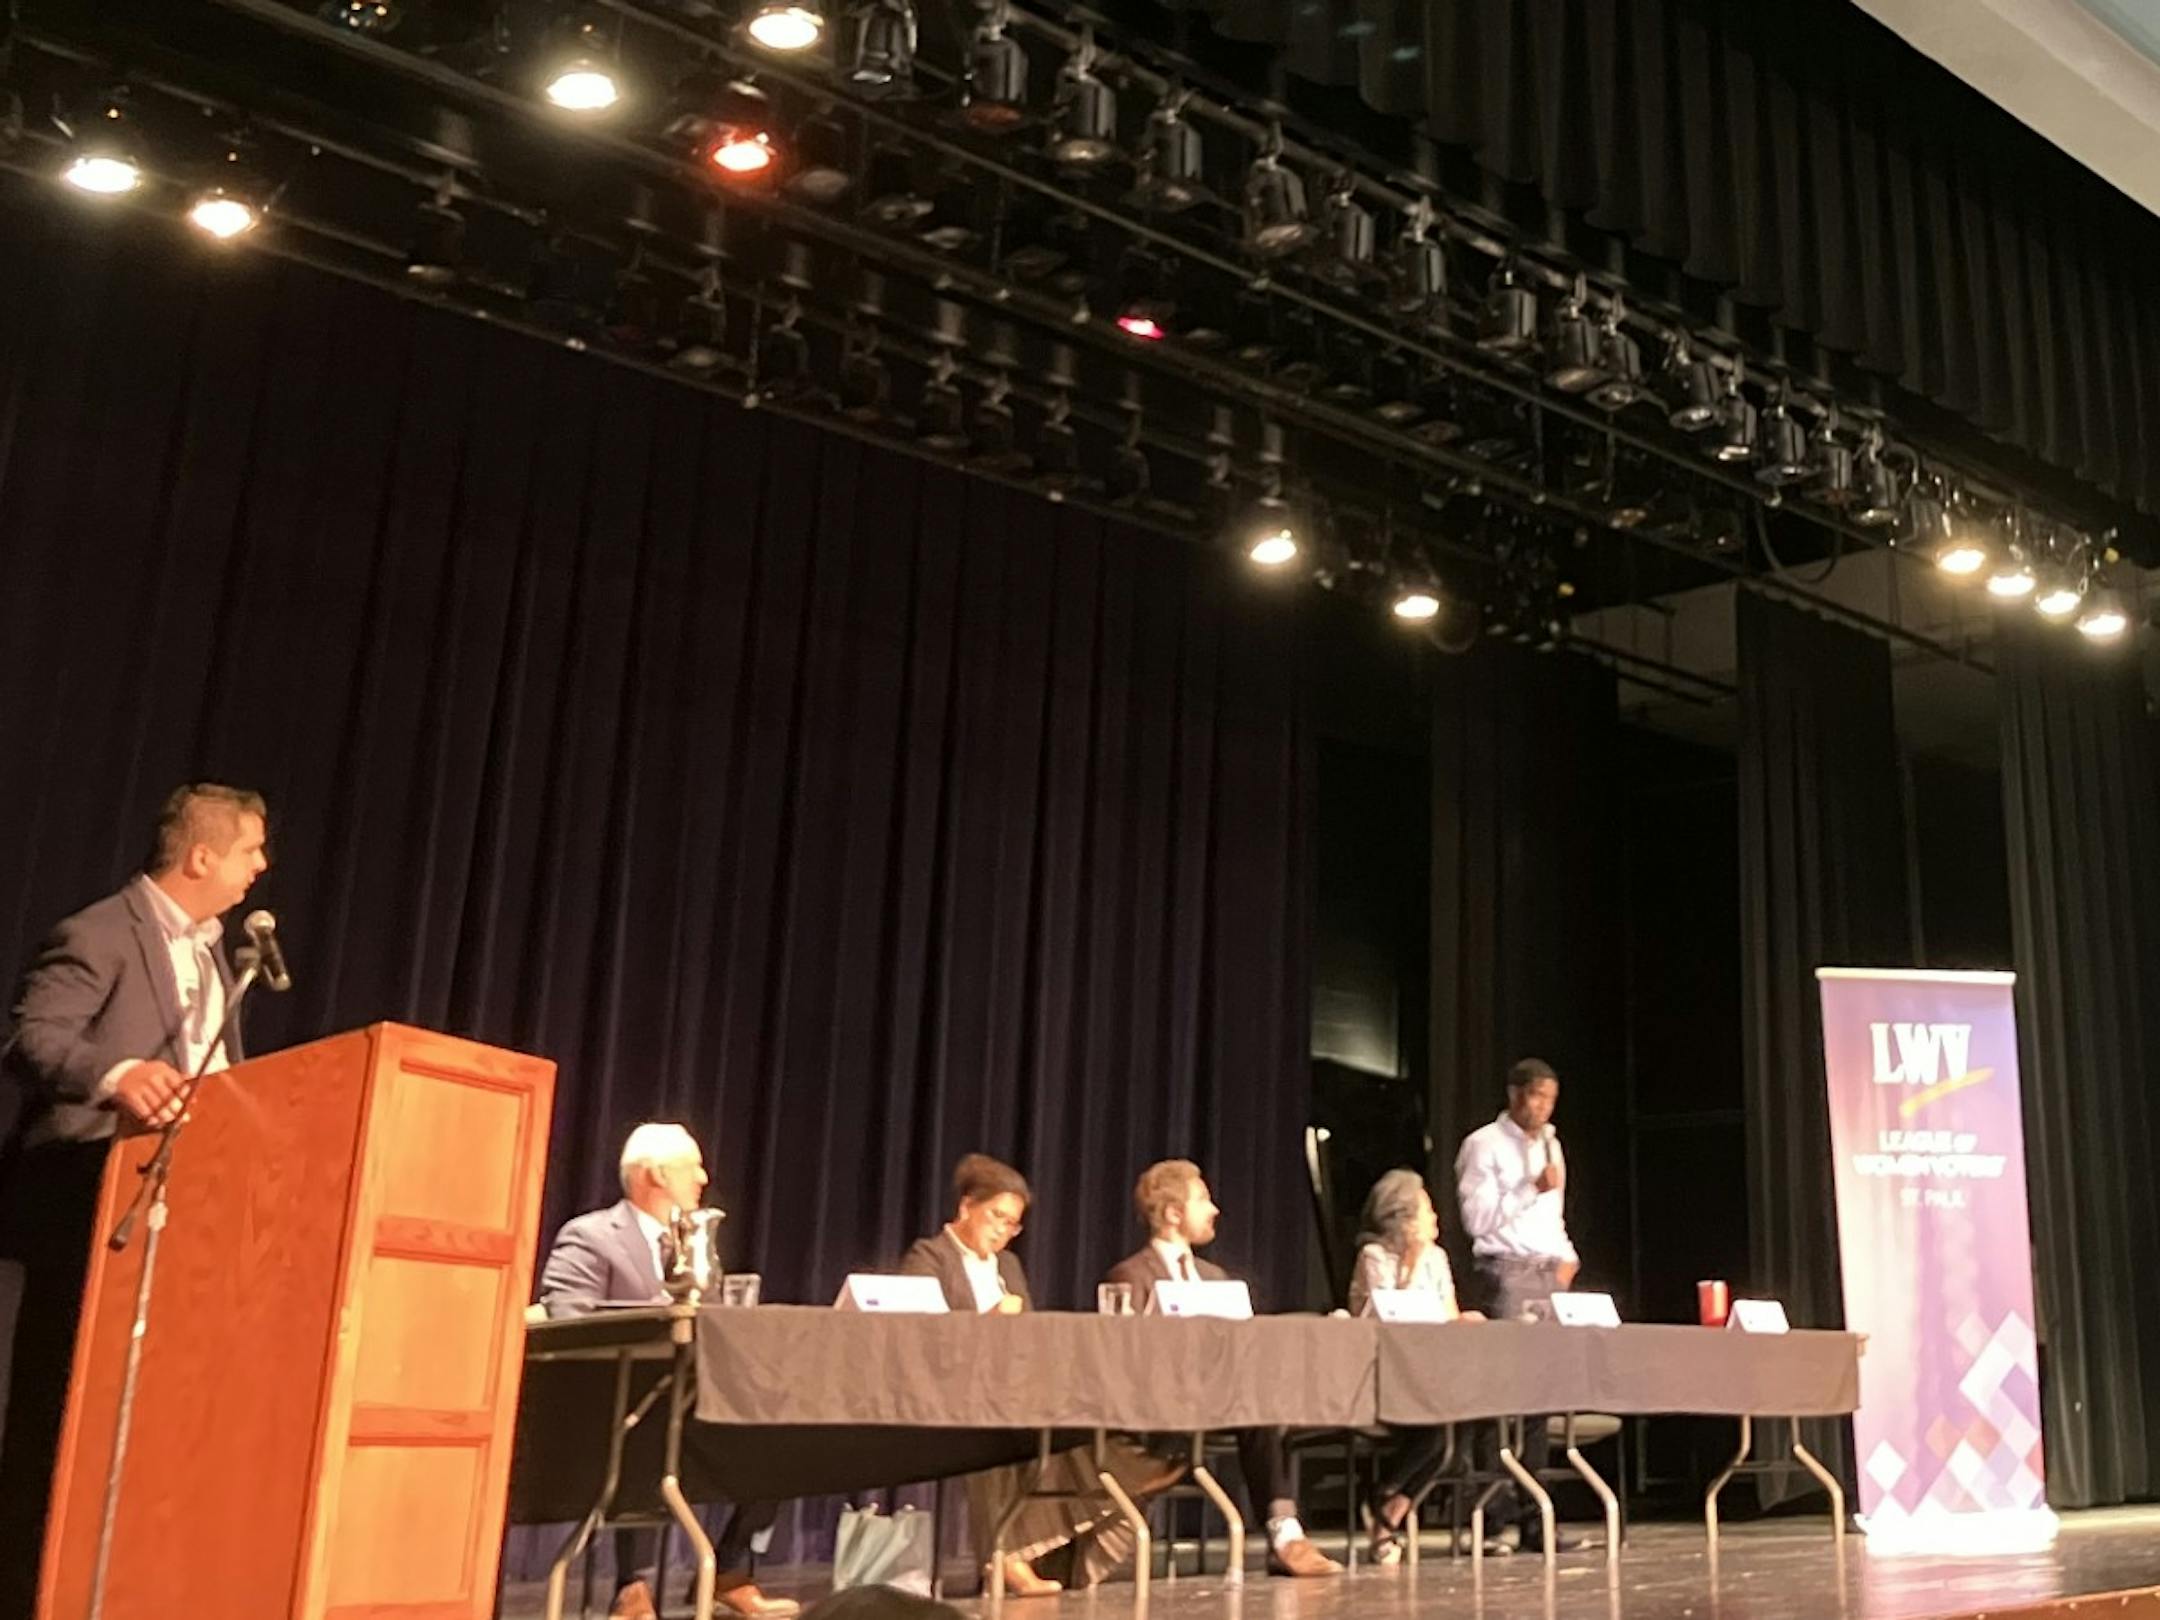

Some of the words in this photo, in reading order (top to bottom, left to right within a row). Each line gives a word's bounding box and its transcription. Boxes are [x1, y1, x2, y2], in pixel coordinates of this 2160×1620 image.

[1869, 1023, 1971, 1085] LWV
[1879, 1130, 1952, 1152] LEAGUE
[1930, 1155, 2006, 1178] VOT
